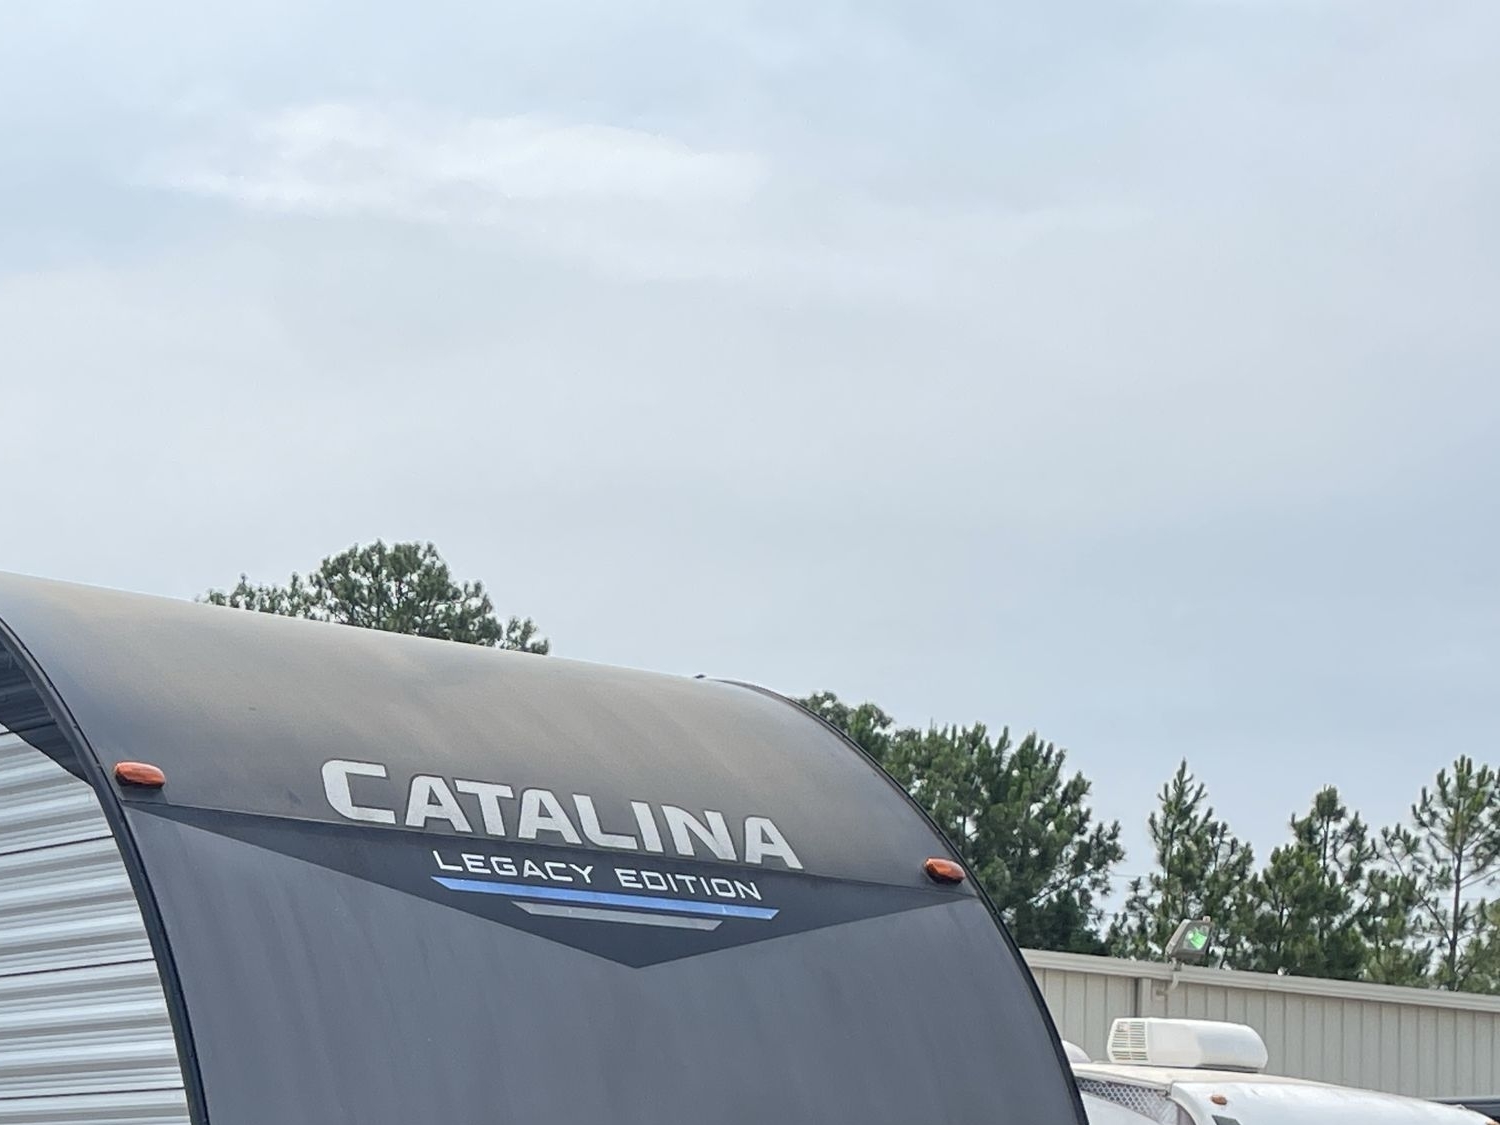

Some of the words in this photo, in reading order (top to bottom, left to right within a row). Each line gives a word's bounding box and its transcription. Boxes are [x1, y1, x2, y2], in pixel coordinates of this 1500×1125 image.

[320, 759, 804, 870] CATALINA
[432, 850, 594, 884] LEGACY
[614, 868, 762, 900] EDITION
